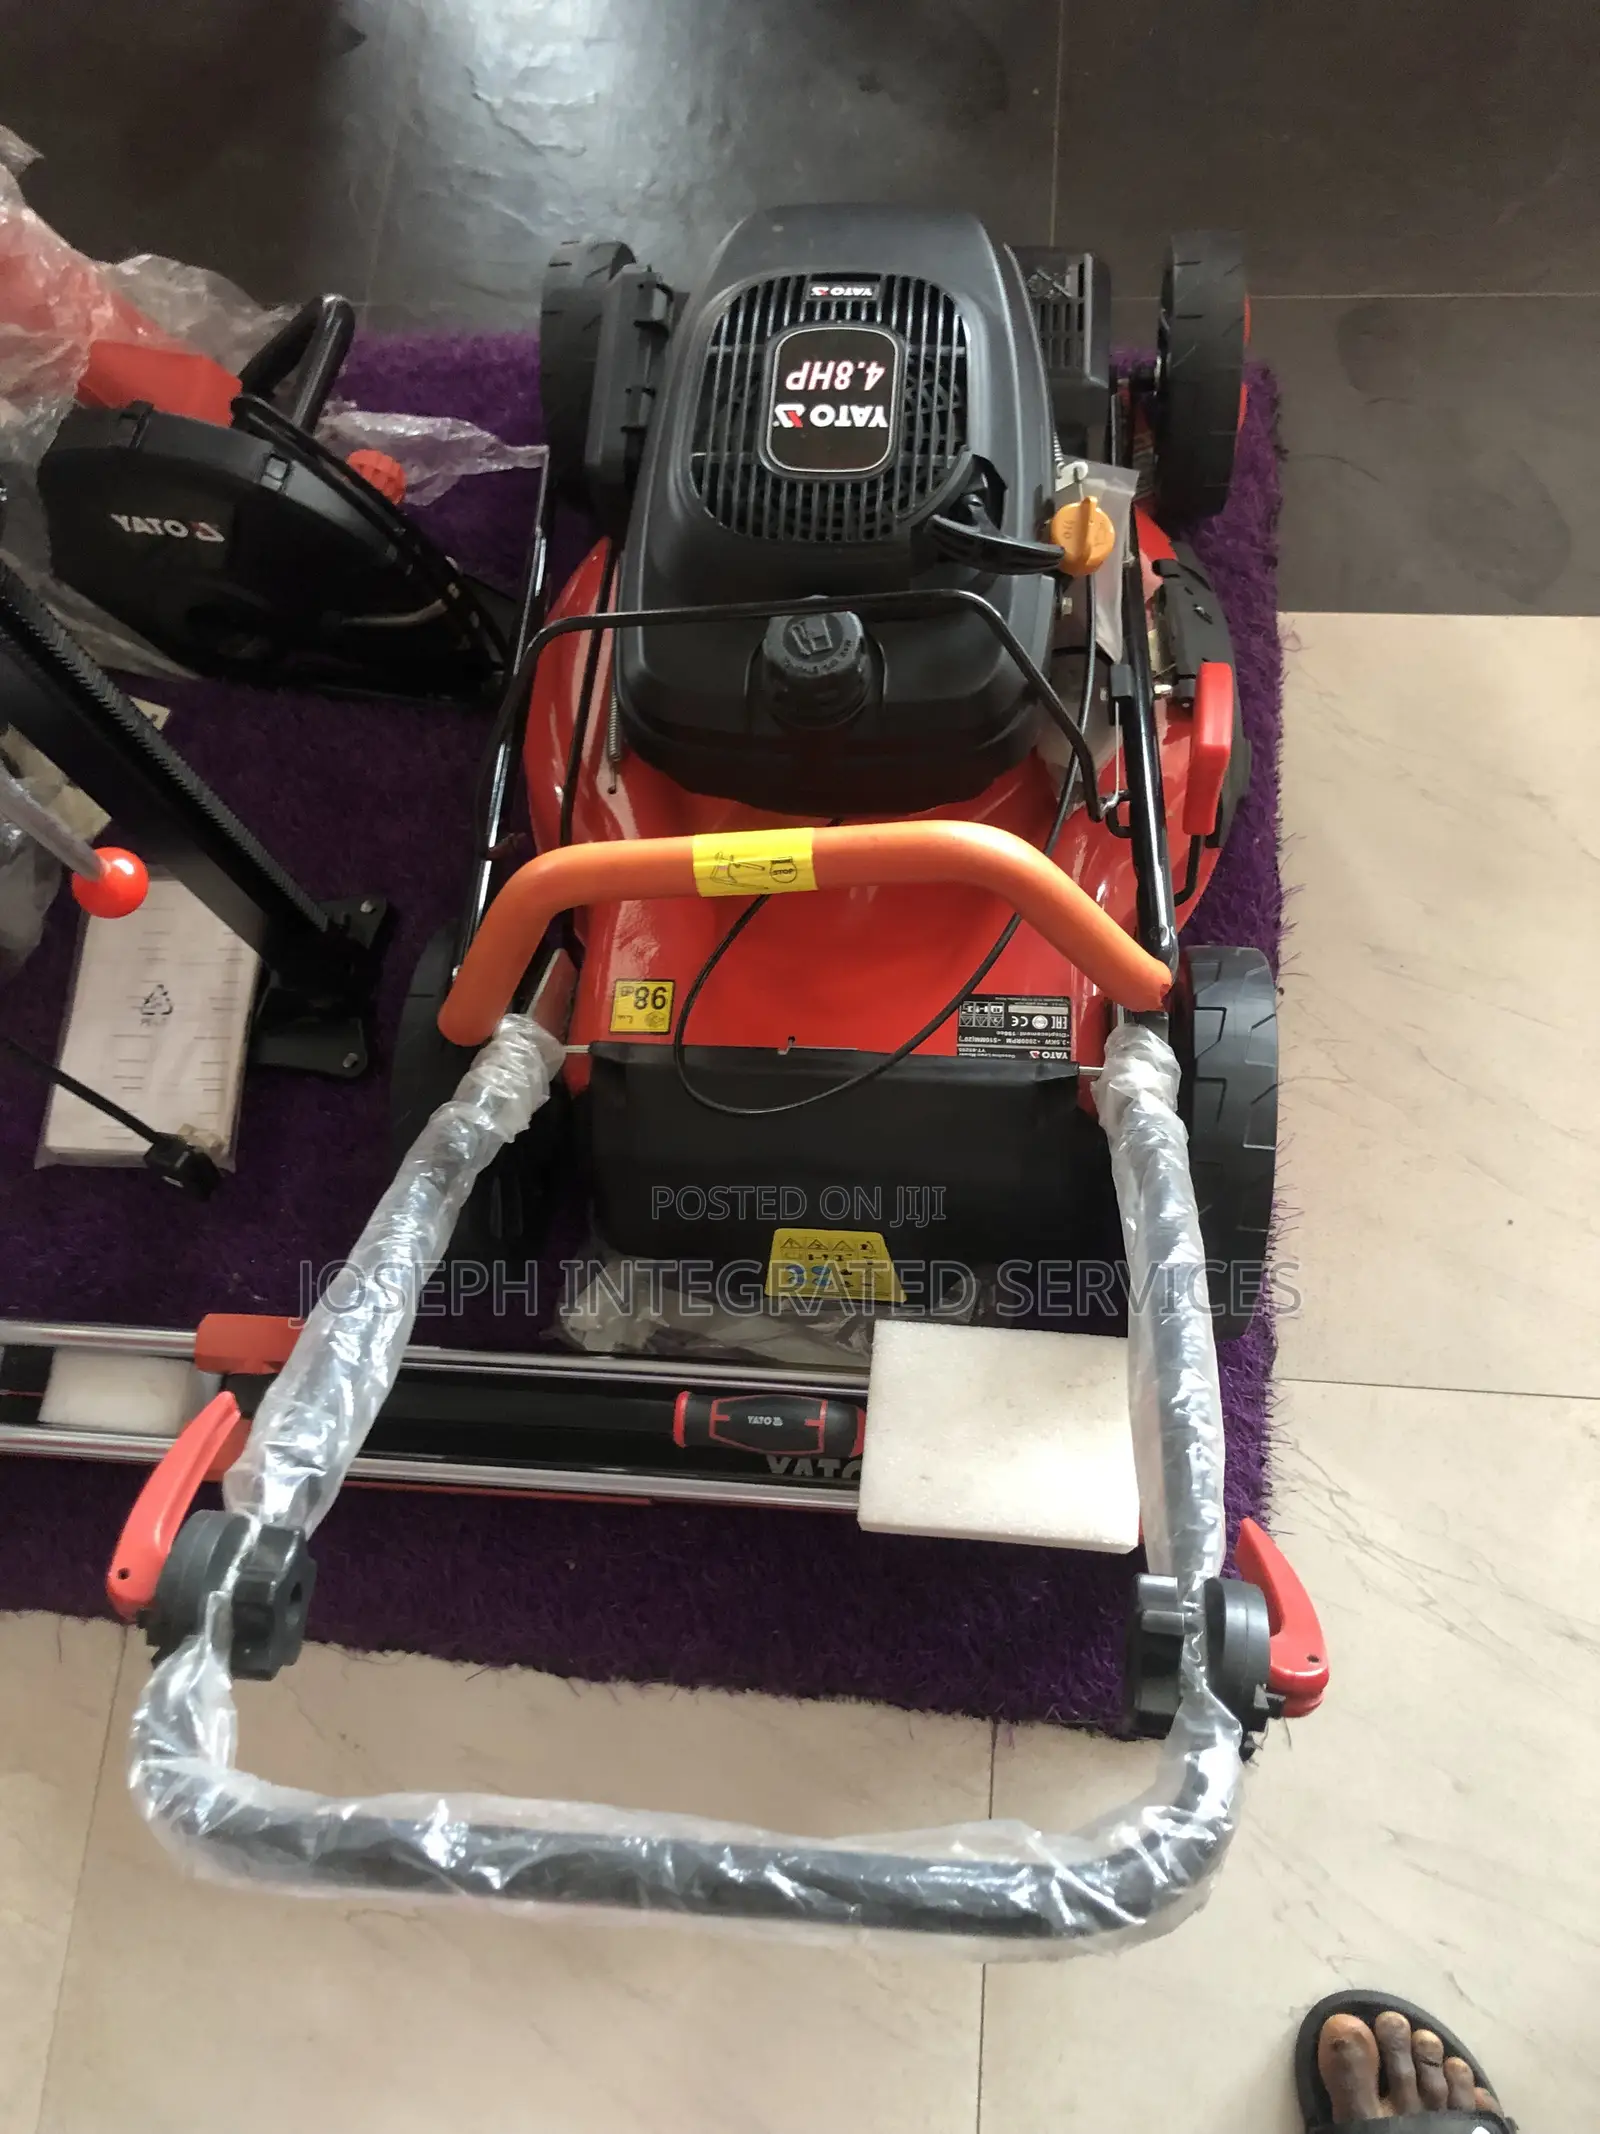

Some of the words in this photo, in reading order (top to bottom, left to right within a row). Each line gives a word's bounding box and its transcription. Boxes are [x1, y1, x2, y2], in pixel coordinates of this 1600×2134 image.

[830, 286, 873, 297] YATO
[785, 360, 885, 391] 4.8HP
[809, 403, 889, 428] YATO
[110, 513, 189, 538] YATO
[634, 986, 667, 1010] 98
[1041, 1051, 1068, 1060] YATO
[747, 1415, 772, 1426] YATO
